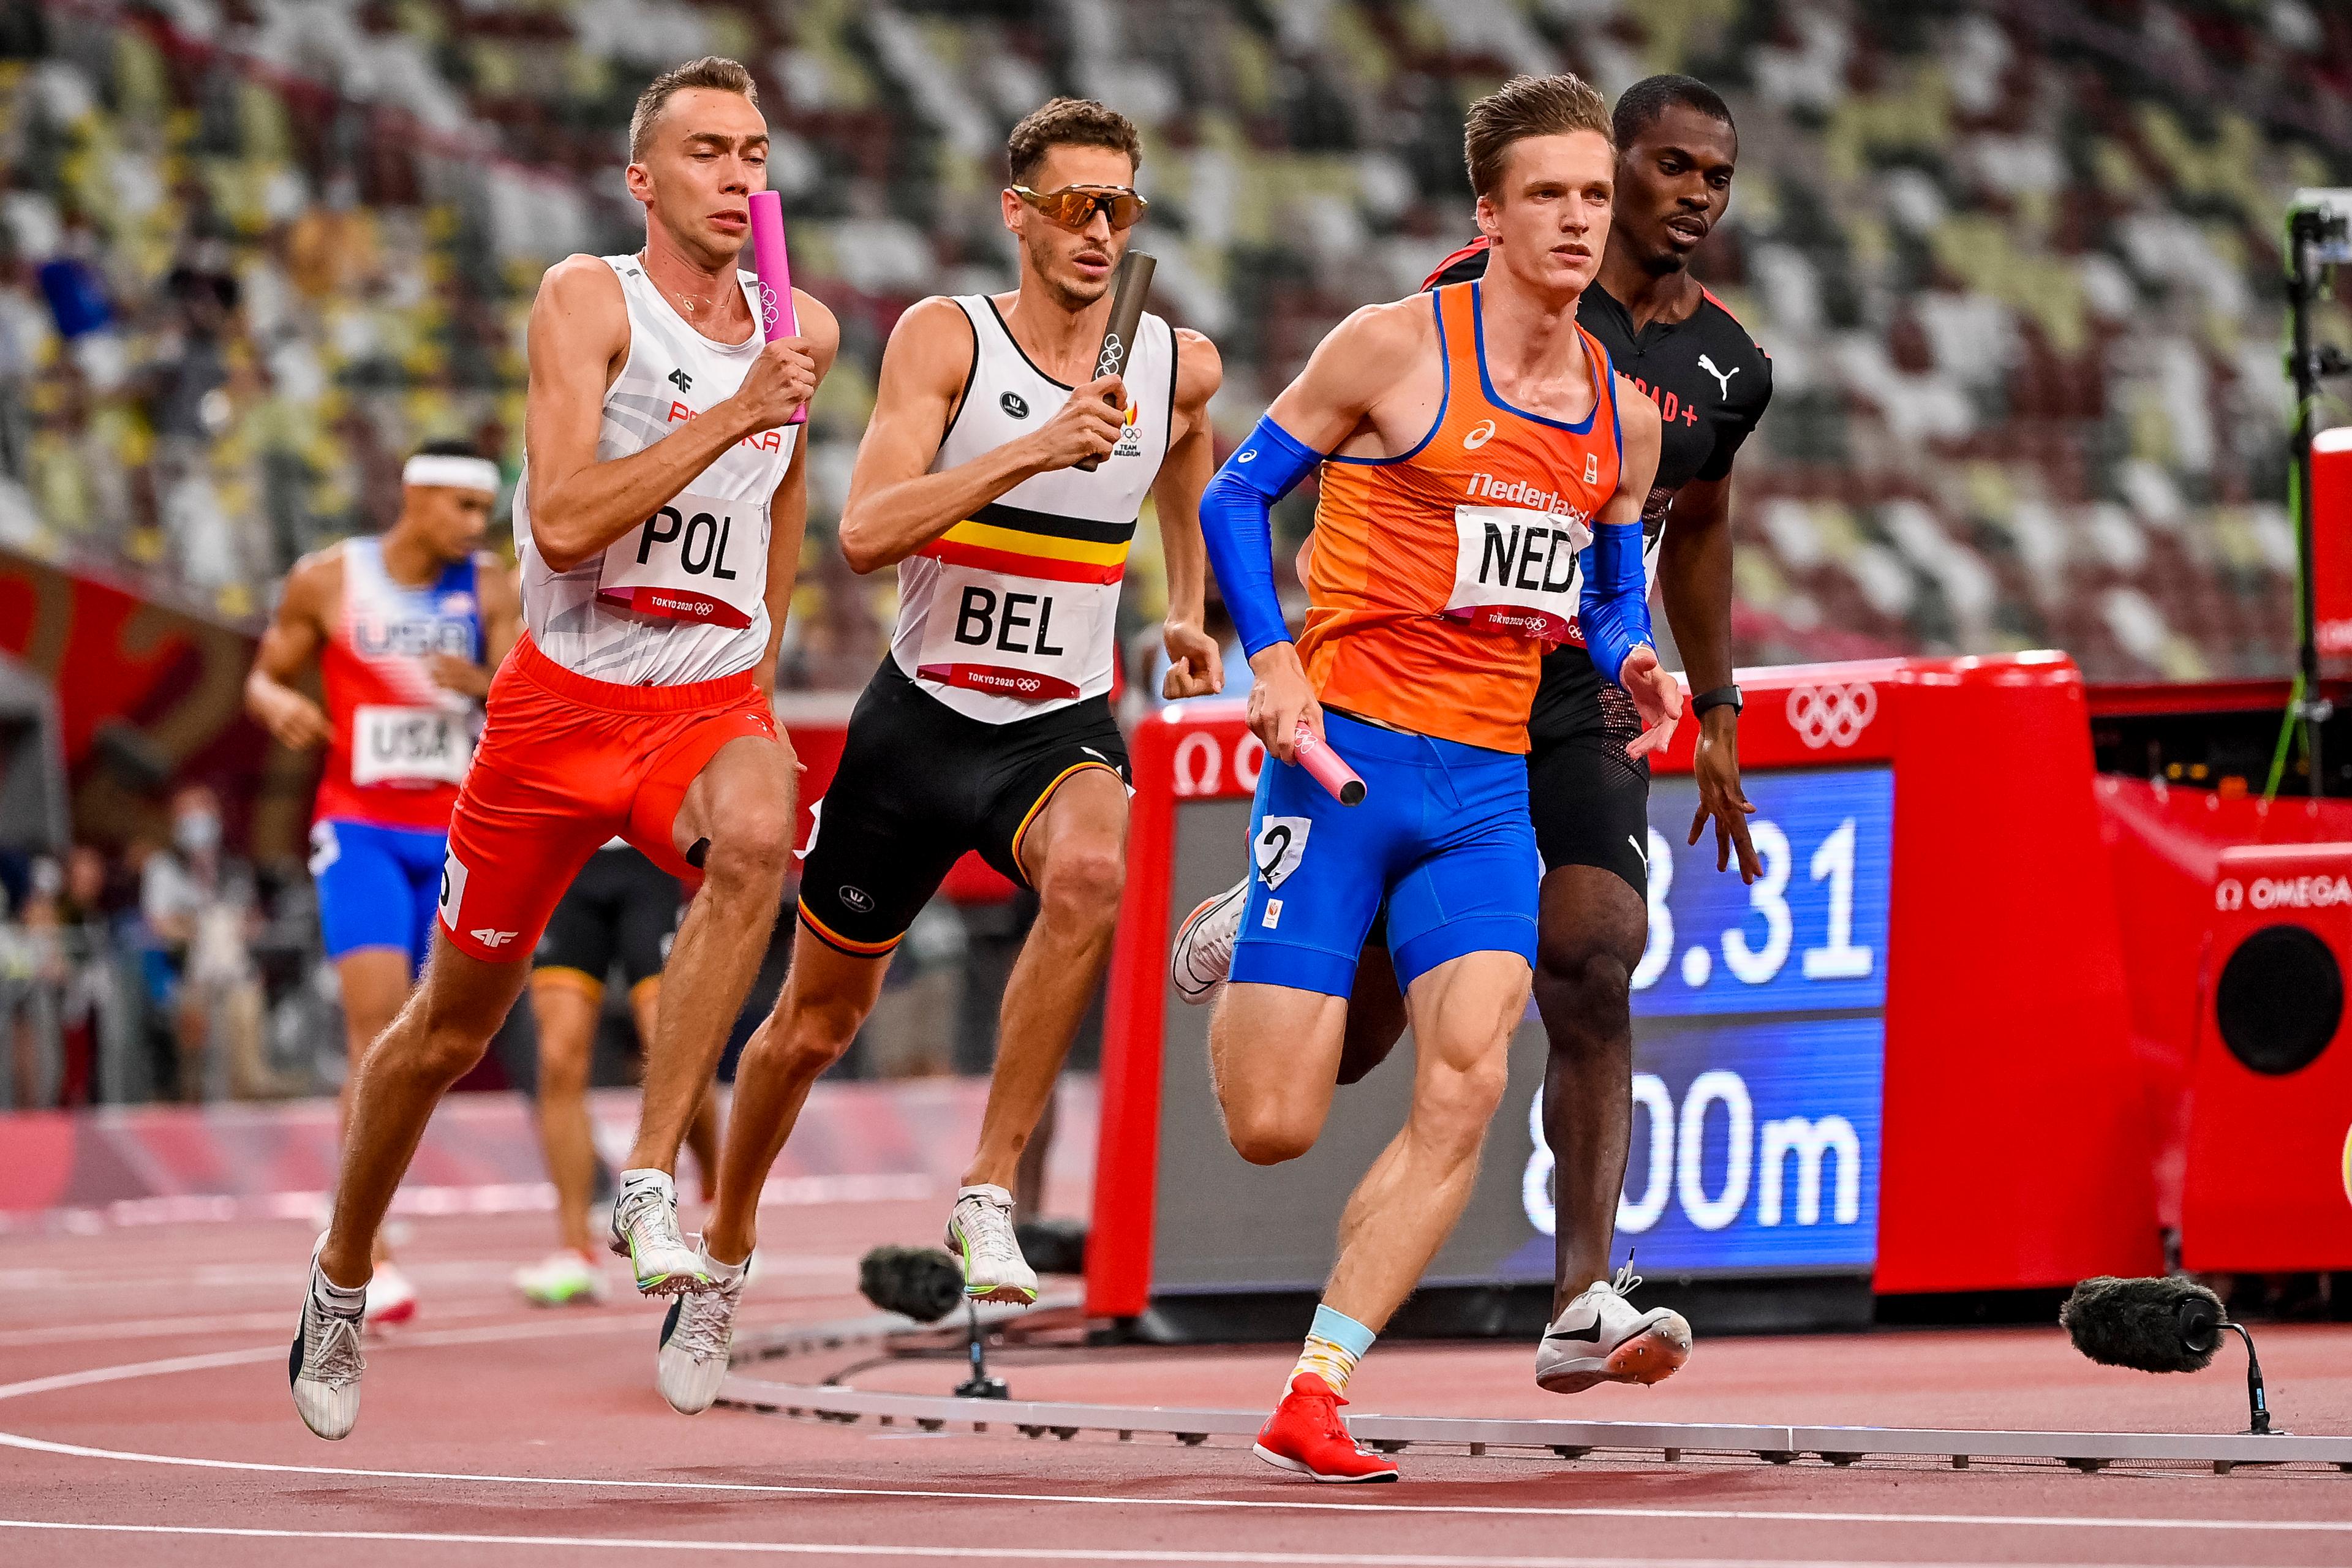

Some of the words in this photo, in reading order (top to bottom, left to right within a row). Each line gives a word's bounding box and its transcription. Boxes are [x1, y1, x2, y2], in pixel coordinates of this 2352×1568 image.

[636, 505, 737, 580] POL
[1479, 522, 1577, 594] NED
[652, 597, 677, 609] TOKYO
[677, 601, 693, 611] 2020
[954, 586, 1064, 656] BEL
[1488, 614, 1510, 625] TOKYO
[1509, 617, 1524, 625] 2020
[968, 672, 994, 685] TOKYO
[995, 677, 1014, 687] 2020
[1259, 824, 1292, 884] 2
[2248, 875, 2352, 910] OMEGA
